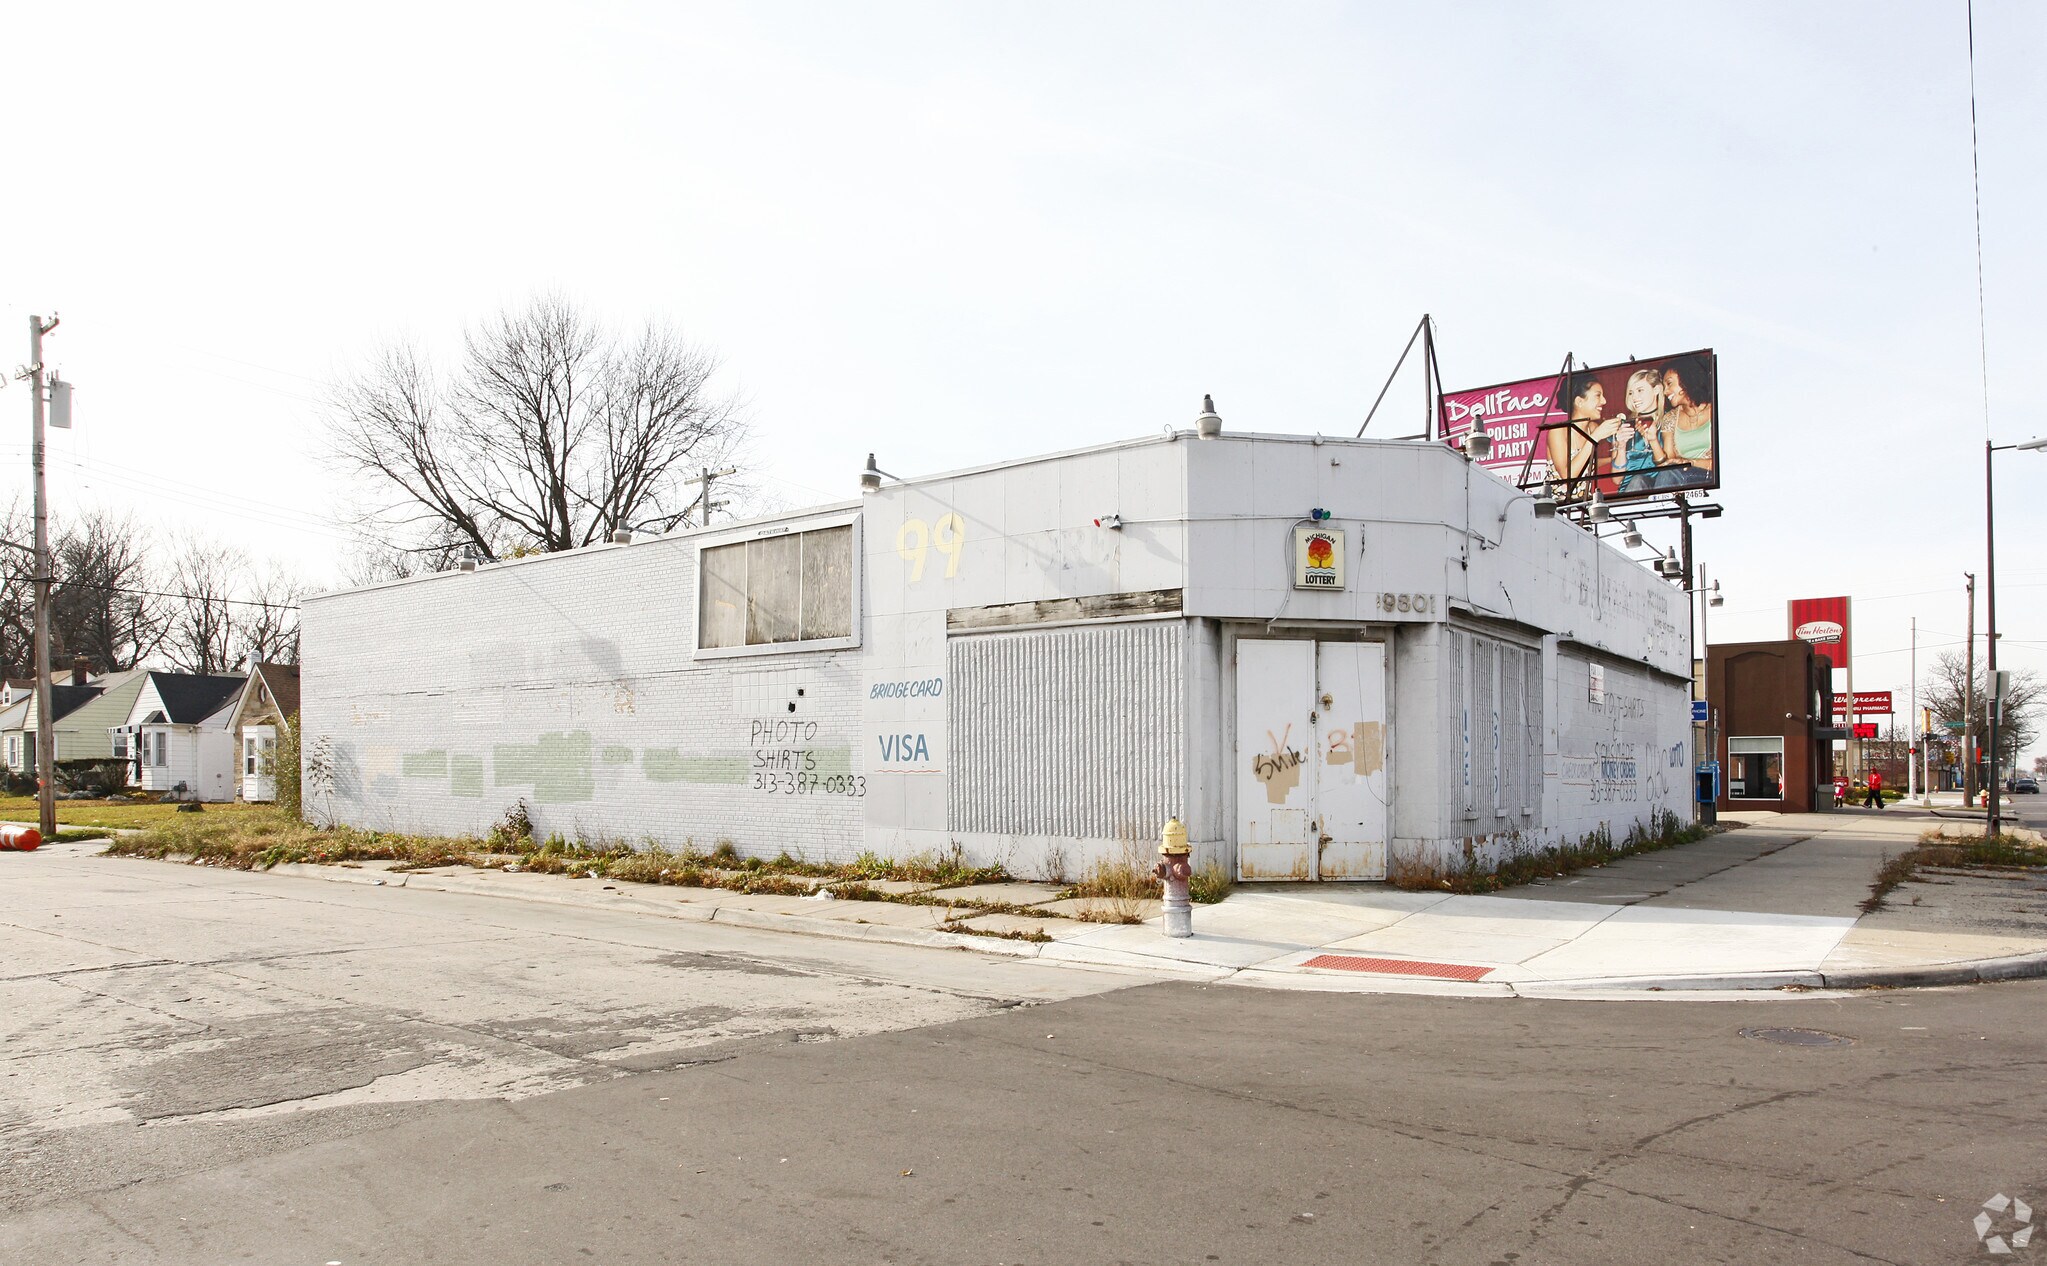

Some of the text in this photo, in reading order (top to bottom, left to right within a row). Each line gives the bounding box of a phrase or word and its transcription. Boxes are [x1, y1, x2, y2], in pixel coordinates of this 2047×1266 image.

[1445, 389, 1549, 421] DollFace
[1486, 422, 1528, 442] POLISH
[1497, 440, 1535, 460] PARTY
[896, 512, 965, 582] 99
[1304, 532, 1337, 545] MICHIGAN
[1305, 574, 1336, 586] LOTTERY
[1797, 626, 1811, 636] Tim
[1833, 695, 1890, 705] Wagreens
[750, 720, 818, 746] PHOTO
[878, 733, 930, 762] VISA
[753, 749, 817, 770] SHIRTS
[1600, 760, 1619, 780] MONEY
[753, 772, 867, 798] 313-387-0333
